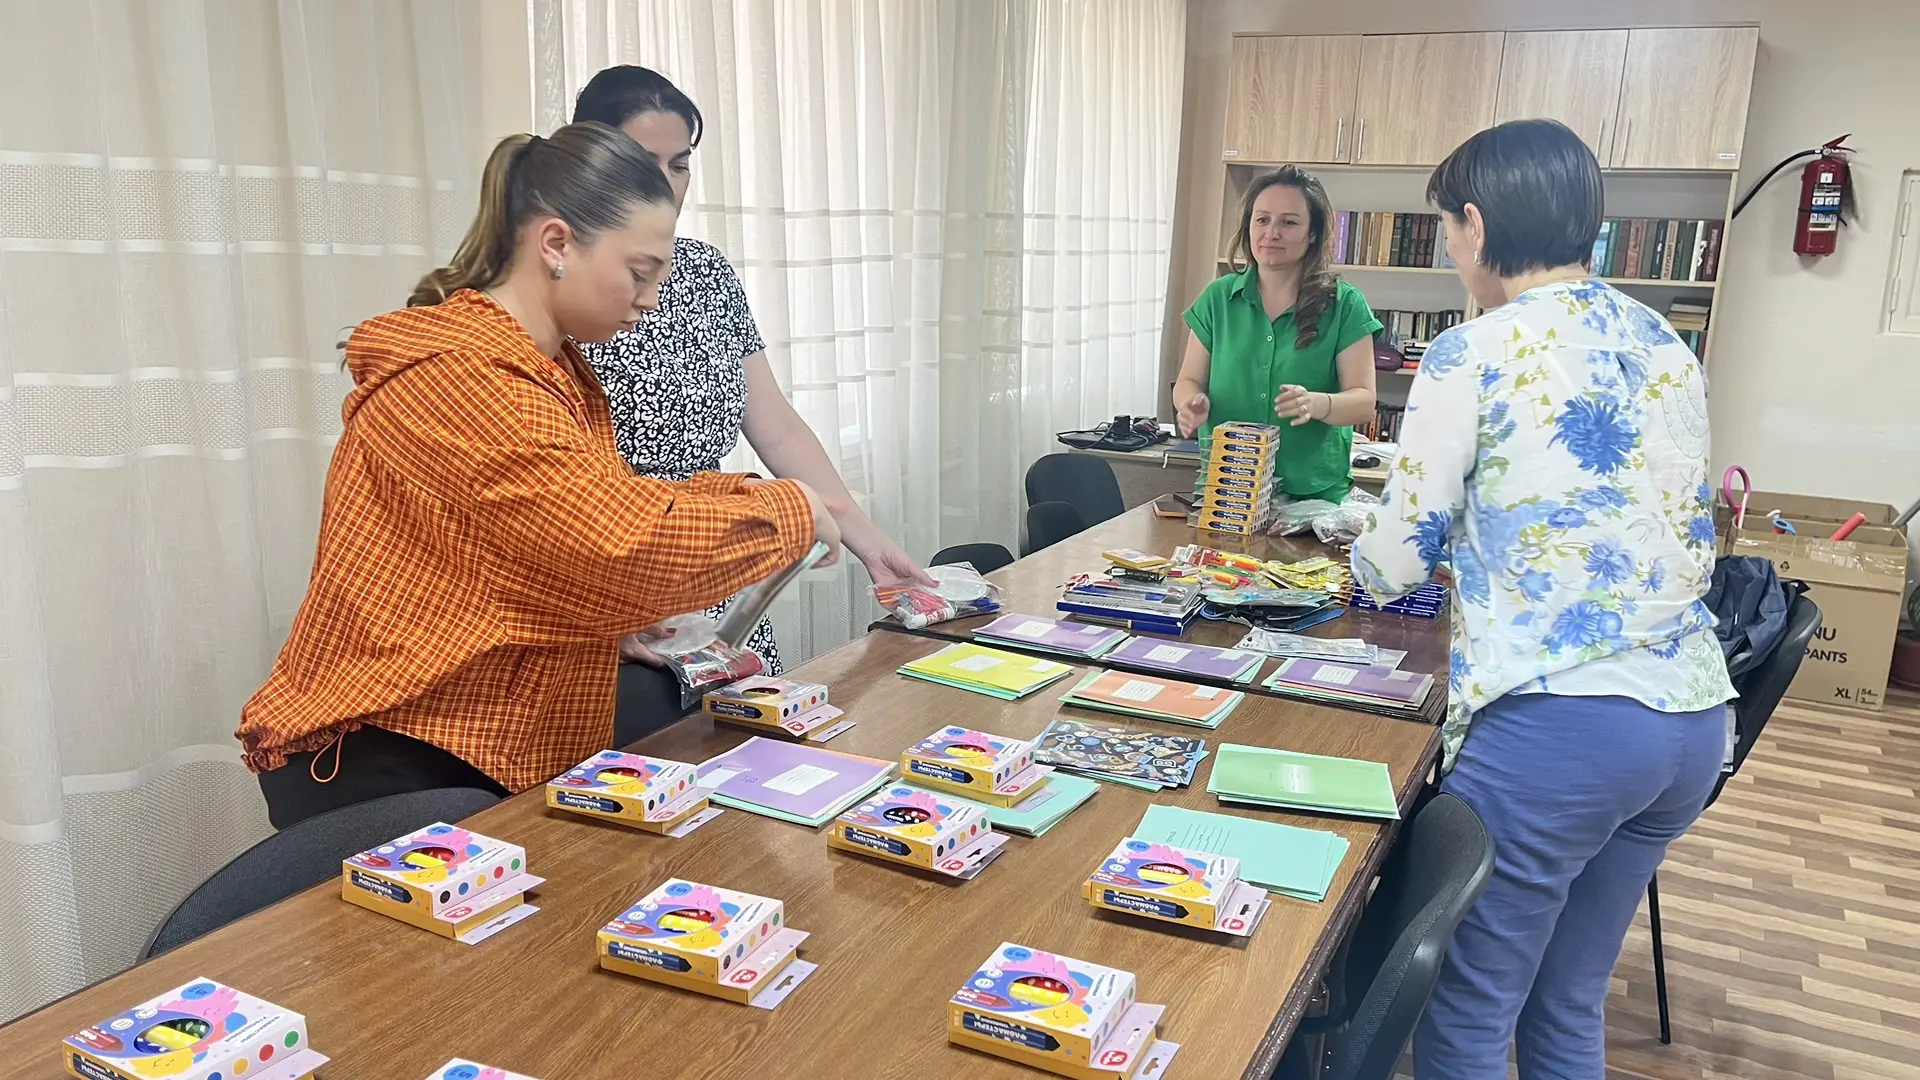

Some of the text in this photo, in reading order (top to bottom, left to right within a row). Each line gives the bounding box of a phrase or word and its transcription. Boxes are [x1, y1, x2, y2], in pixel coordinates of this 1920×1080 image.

[1834, 687, 1852, 700] XL
[917, 765, 953, 778] ФЛОМАСТЕРЫ
[564, 795, 602, 808] ФЛОМАСТЕРЫ
[852, 833, 889, 848] ФЛОМАСТЕРЫ
[358, 879, 393, 895] ФЛОМАСТЕРЫ
[1114, 896, 1161, 911] ФЛОМАСТЕРЫ
[617, 950, 664, 965] ФЛОМАСТЕРЫ
[974, 1021, 1027, 1041] ФЛОМАСТЕРЫ
